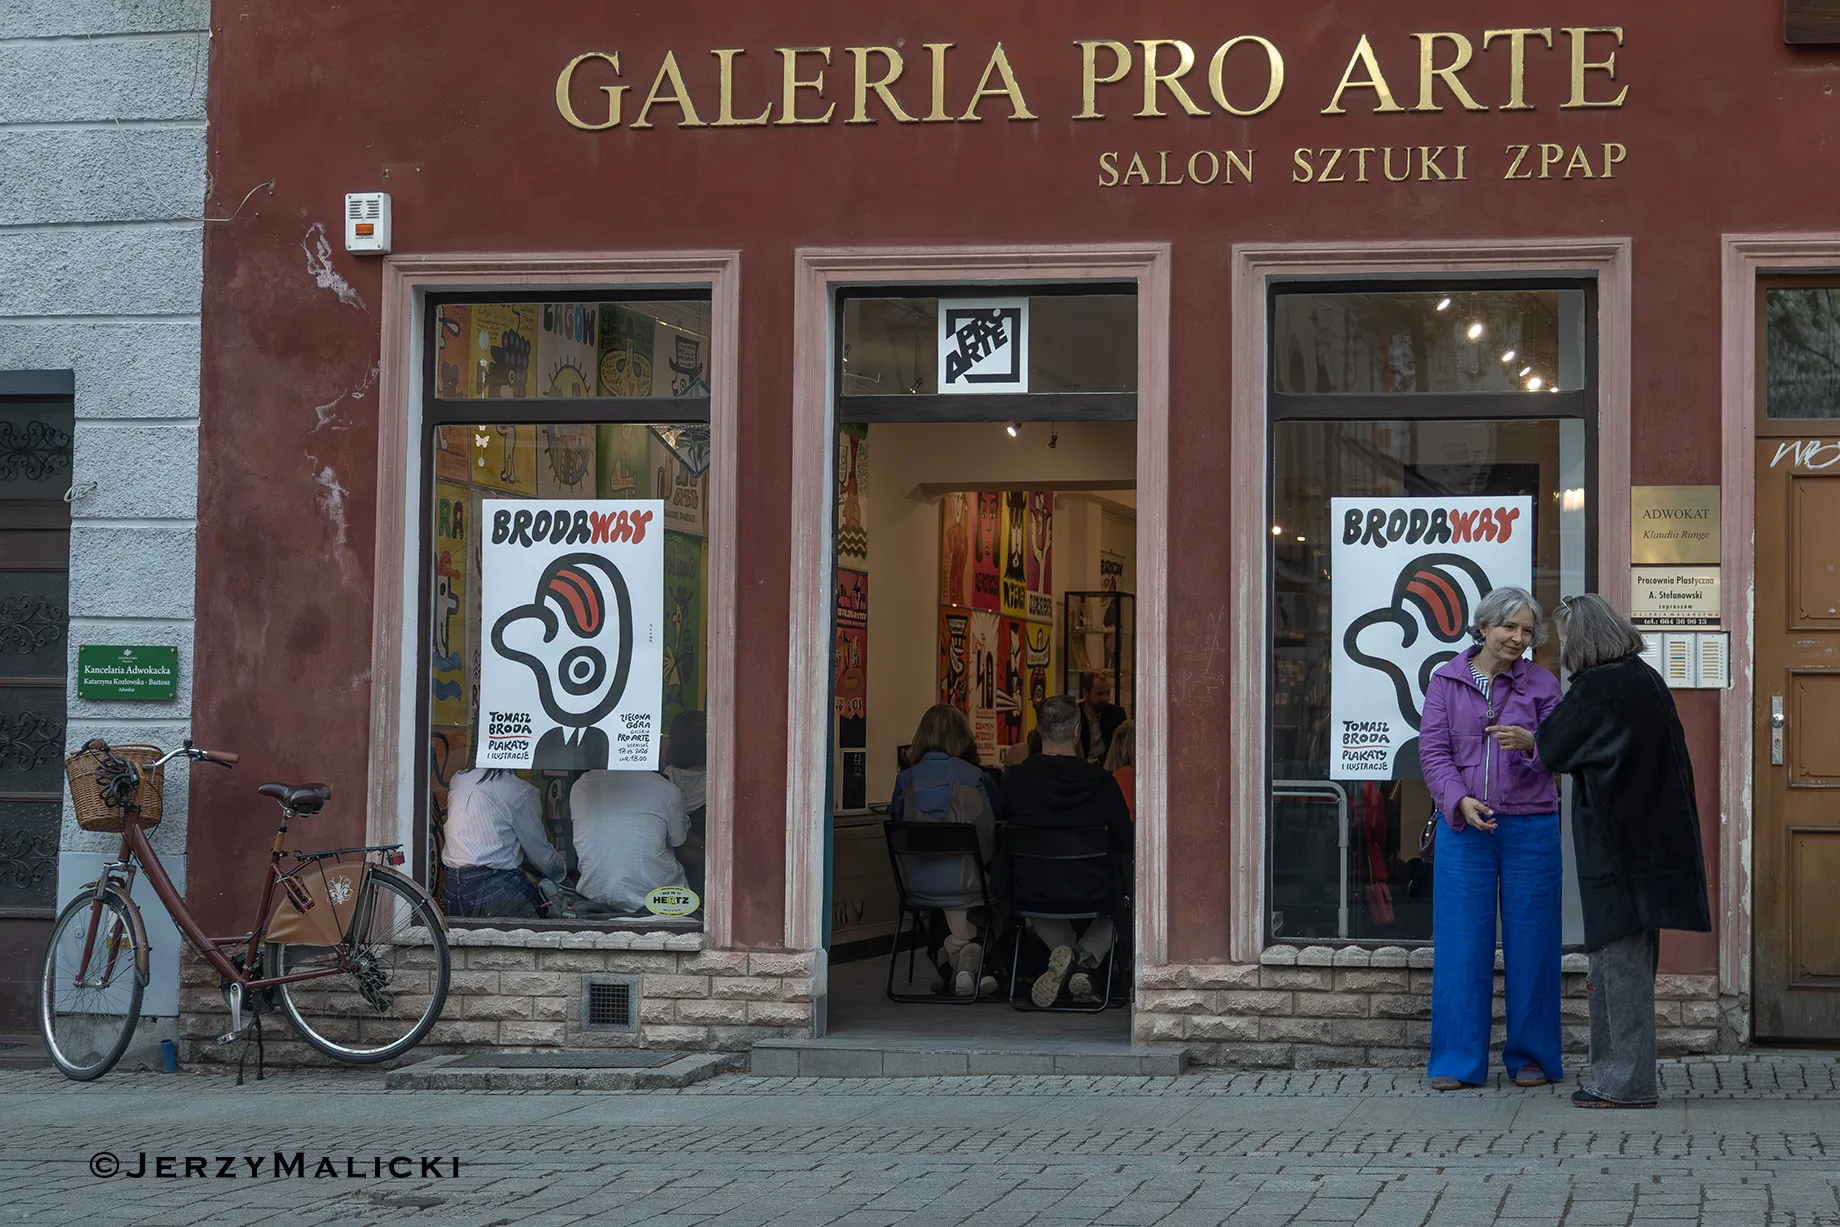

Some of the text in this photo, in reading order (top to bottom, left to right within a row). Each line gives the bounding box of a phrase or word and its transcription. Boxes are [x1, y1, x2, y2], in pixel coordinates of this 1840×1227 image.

[555, 26, 1631, 130] GALERIA PRO ARTE
[1098, 142, 1628, 188] SALON SZTUKI ZPAP
[956, 308, 1004, 350] PRO
[945, 325, 1009, 385] ARTE
[1642, 508, 1710, 520] ADWOKAT
[491, 509, 654, 548] BRODAWAY
[1342, 506, 1520, 549] BRODAWAY
[1642, 529, 1710, 541] Klaudia Runge
[1637, 576, 1715, 587] Pracownia Plastyczna
[1648, 590, 1703, 599] A. Stefanowski
[84, 665, 171, 675] Kancelaria Adwokacka
[83, 678, 112, 686] Katarzyna
[148, 678, 171, 686] Bartosz
[488, 711, 532, 723] TOMASZ
[619, 712, 651, 723] ZIELONA
[488, 723, 533, 735] BRODA
[626, 720, 651, 729] GÓRA
[1342, 720, 1390, 732] TOMASZ
[617, 733, 650, 742] PRO ARTE
[1342, 732, 1391, 745] BRODA
[488, 740, 529, 751] PLAKATY
[491, 751, 529, 760] ILUSTRACJE
[1341, 750, 1388, 761] PLAKATY
[1346, 761, 1389, 771] ILUSTRACJE
[653, 896, 689, 905] HERTZ
